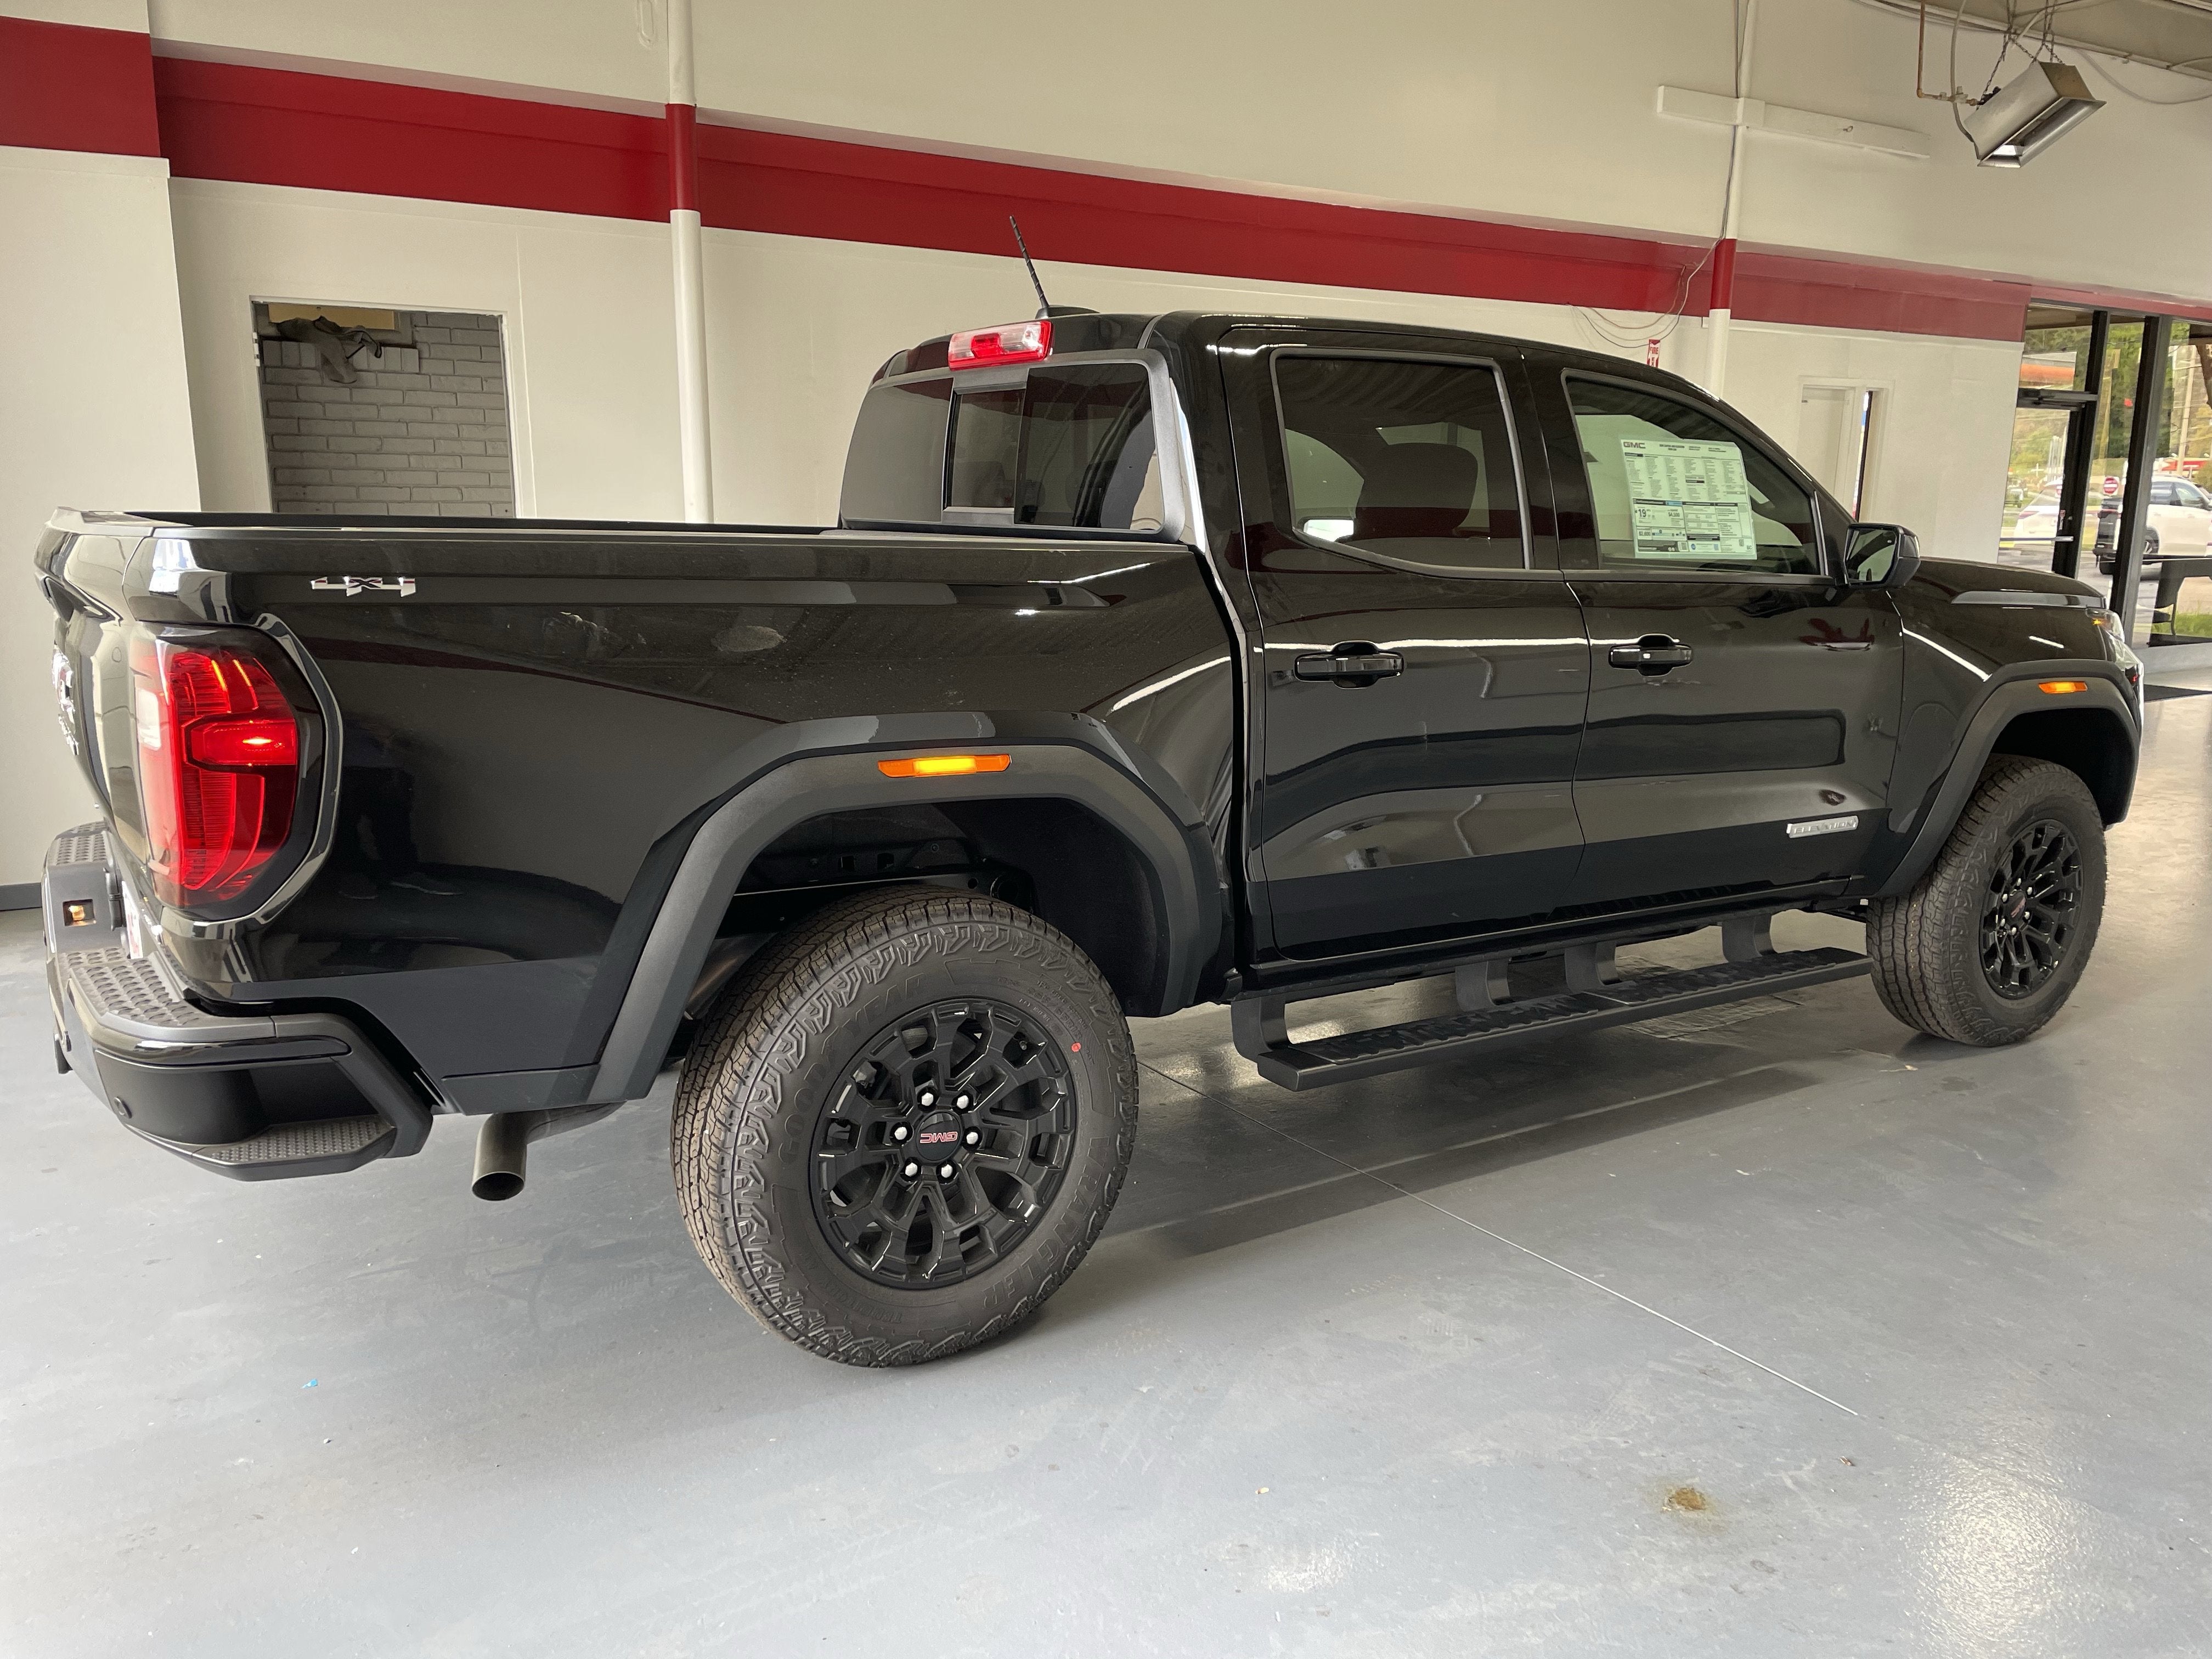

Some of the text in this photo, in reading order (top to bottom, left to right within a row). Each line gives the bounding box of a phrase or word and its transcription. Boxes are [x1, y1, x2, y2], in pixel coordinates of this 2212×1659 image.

[1638, 509, 1646, 517] 19
[1794, 819, 1857, 834] ELEVATION
[919, 1131, 958, 1143] GMC
